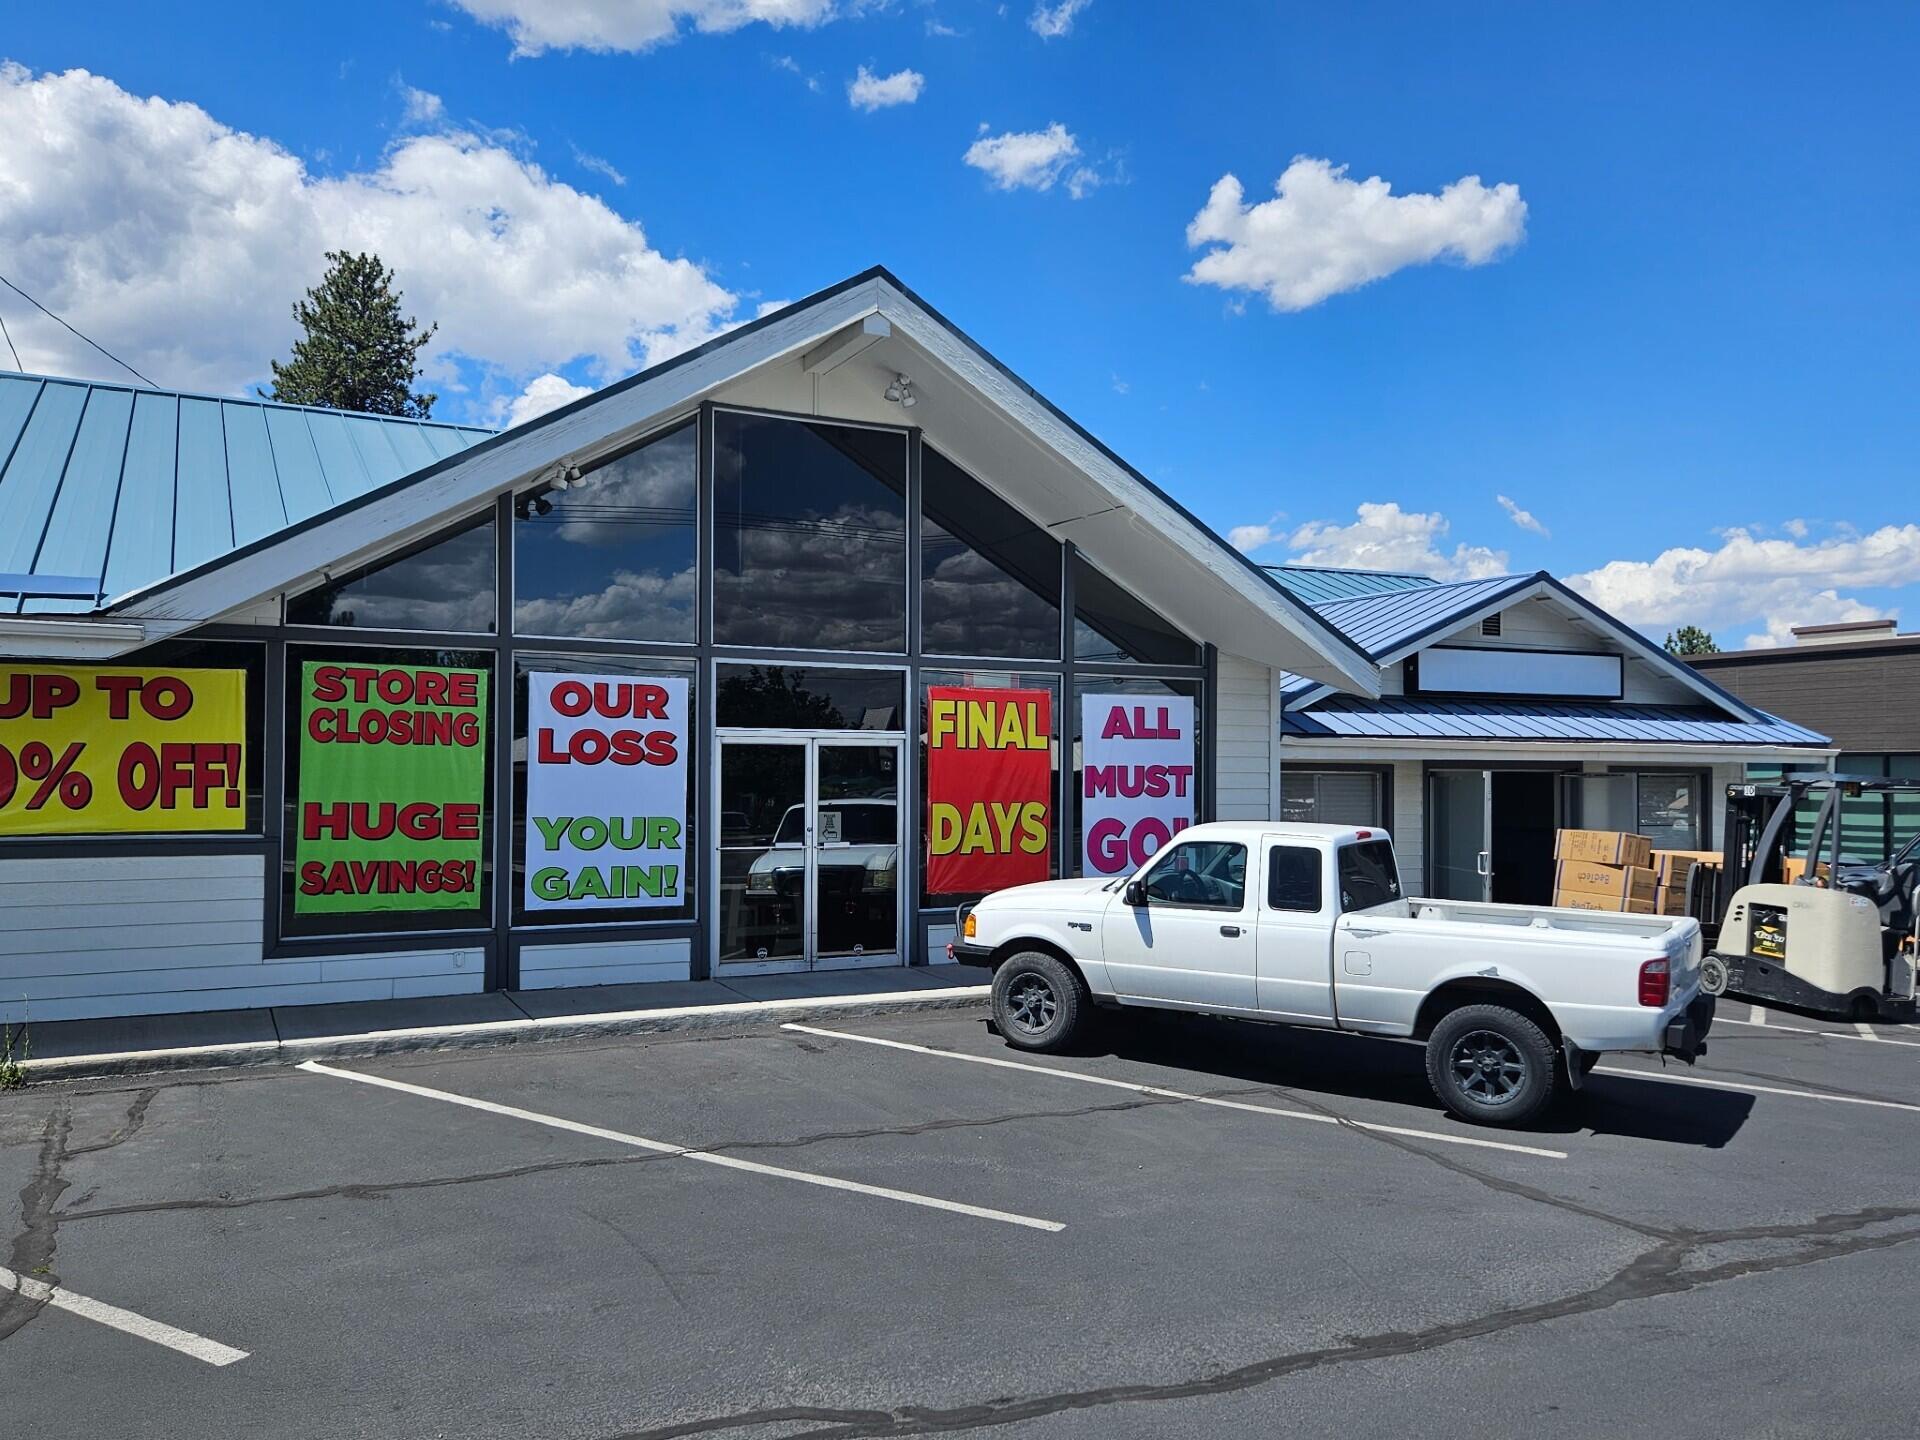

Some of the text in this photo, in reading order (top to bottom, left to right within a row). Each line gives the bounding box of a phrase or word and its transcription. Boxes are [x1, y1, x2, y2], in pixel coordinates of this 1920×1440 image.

[96, 675, 194, 721] TO
[312, 666, 478, 708] STORE
[549, 680, 670, 720] OUR
[308, 707, 479, 748] CLOSING
[931, 700, 1048, 750] FINAL
[1101, 706, 1181, 740] ALL
[537, 727, 679, 767] LOSS
[117, 741, 242, 811] OFF!
[1084, 765, 1193, 799] MUST
[303, 802, 480, 841] HUGE
[532, 816, 681, 851] YOUR
[930, 801, 1048, 856] DAYS
[300, 860, 477, 896] SAVINGS!
[530, 865, 679, 901] GAIN!
